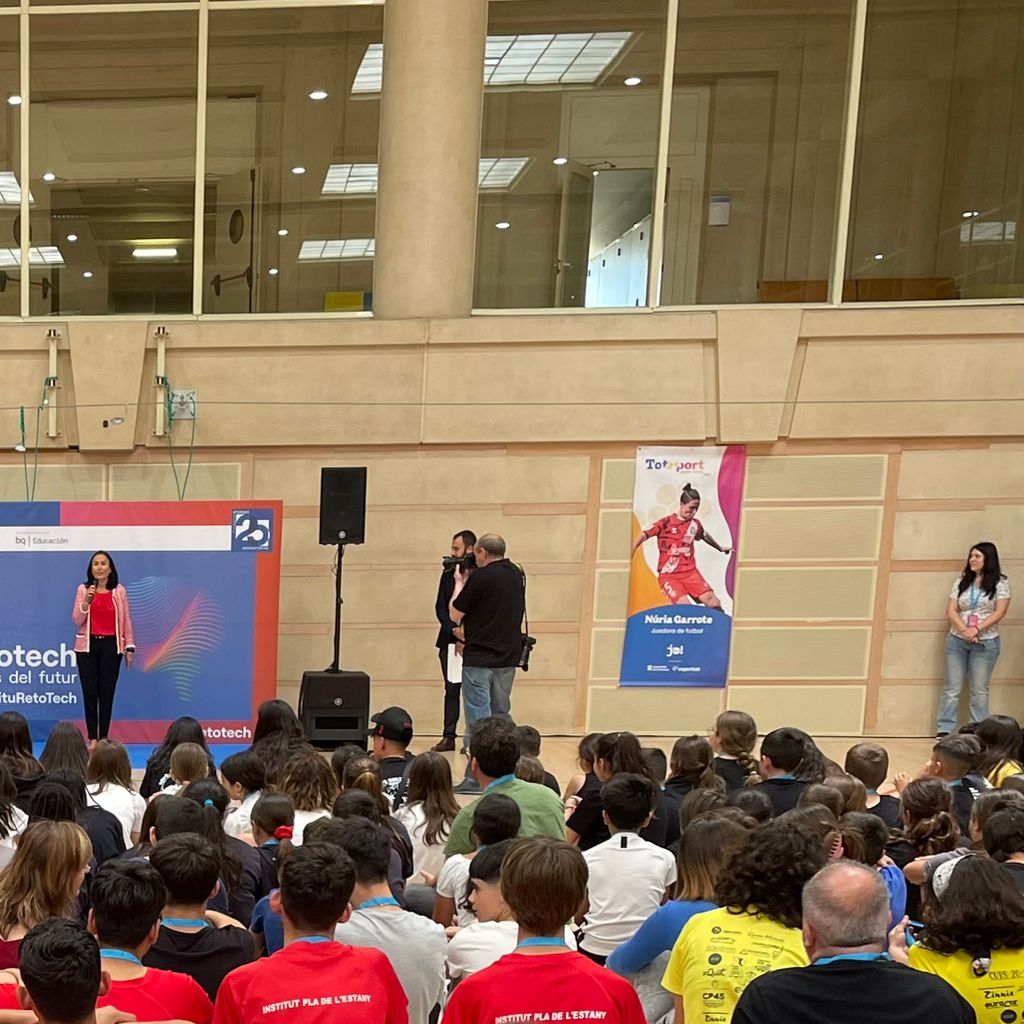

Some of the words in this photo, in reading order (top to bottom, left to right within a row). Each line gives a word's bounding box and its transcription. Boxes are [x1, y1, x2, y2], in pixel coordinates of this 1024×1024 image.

[15, 537, 26, 546] bq
[32, 537, 68, 545] Educación
[645, 614, 673, 624] Núria
[674, 615, 713, 624] Garrote
[9, 670, 32, 684] del
[39, 670, 78, 684] futur
[202, 726, 252, 739] totech
[262, 999, 300, 1014] INSTITUT
[302, 998, 319, 1007] PLA
[320, 997, 332, 1005] DE
[335, 994, 371, 1004] L'ESTANY
[495, 1013, 532, 1024] INSTITUT
[534, 1012, 550, 1021] PLA
[551, 1012, 564, 1020] DE
[565, 1010, 607, 1019] L'ESTANY
